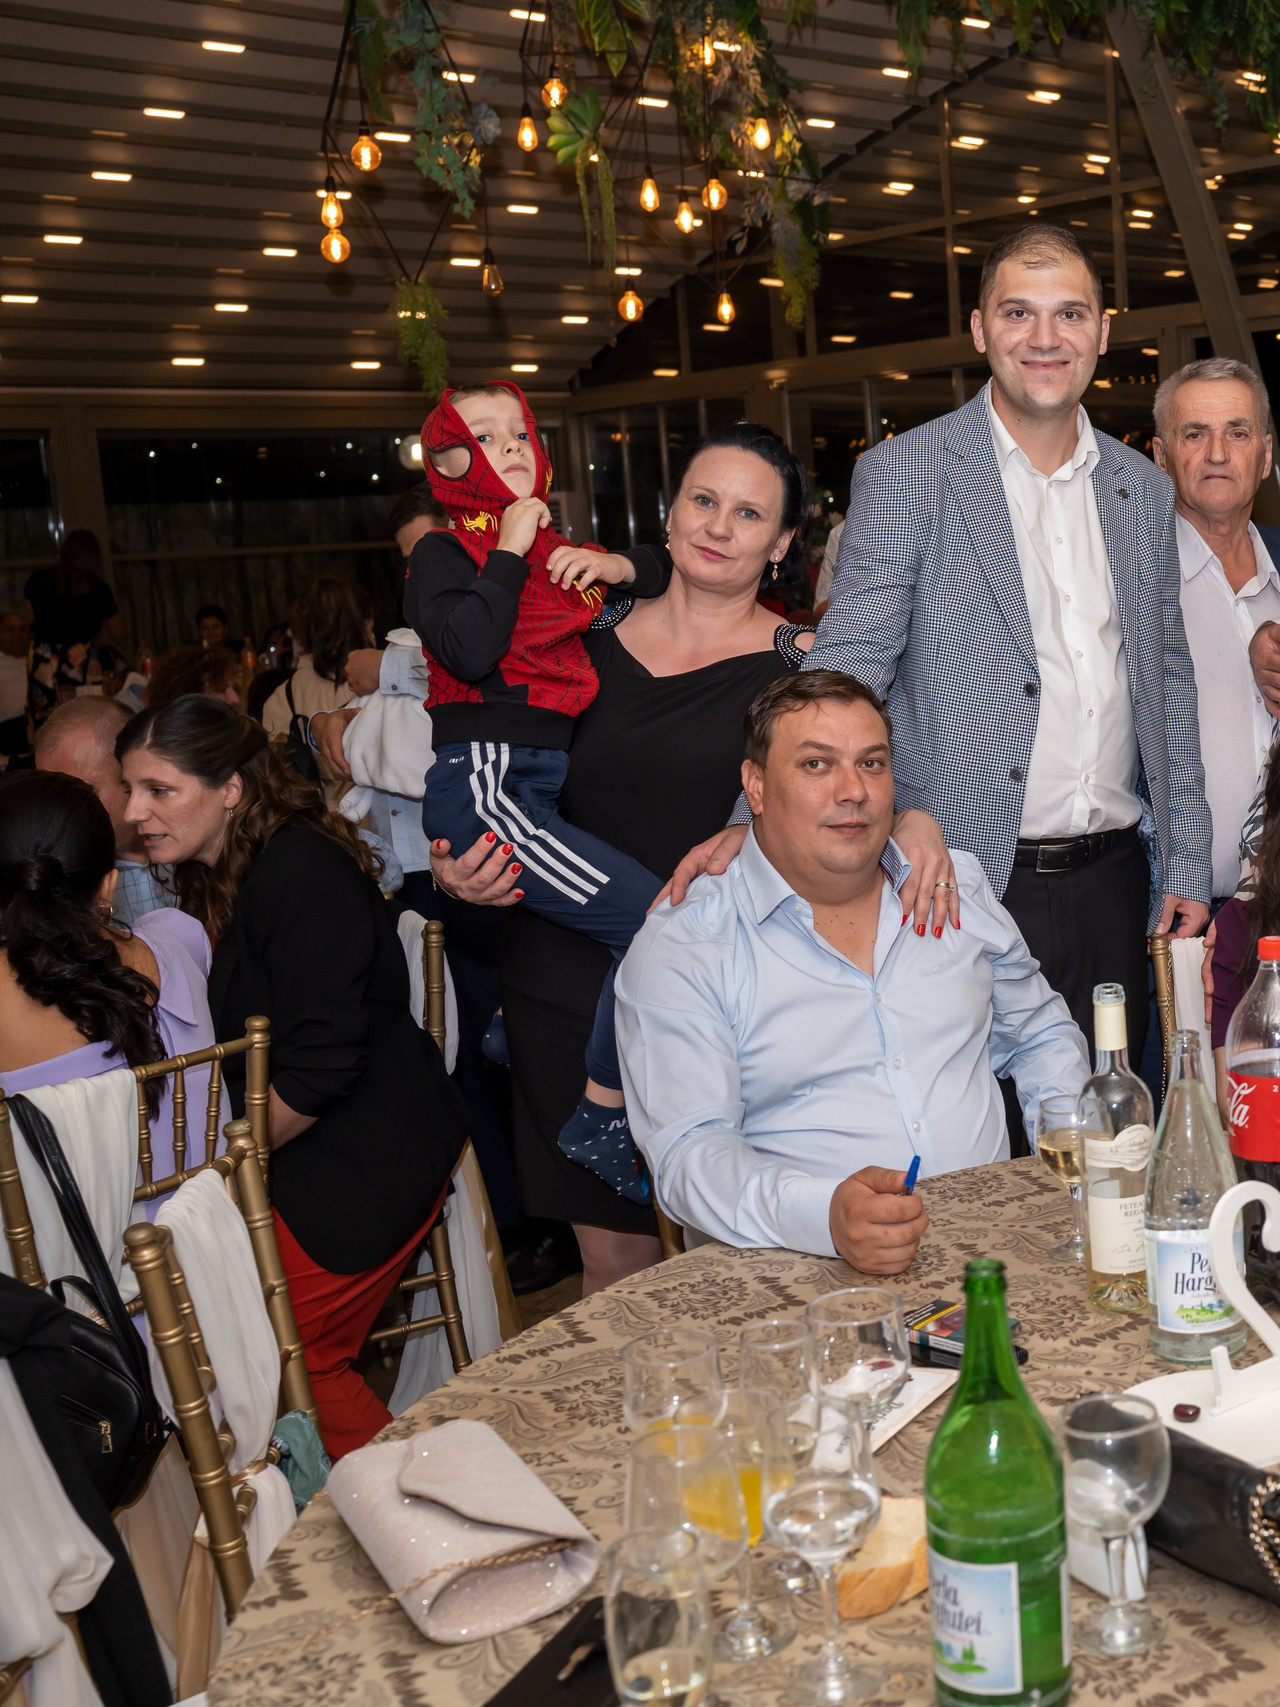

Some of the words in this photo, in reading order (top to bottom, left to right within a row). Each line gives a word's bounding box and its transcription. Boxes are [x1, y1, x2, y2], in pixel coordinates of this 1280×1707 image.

[1119, 1200, 1145, 1211] FETEA
[1190, 1252, 1211, 1274] Pe
[1174, 1272, 1217, 1295] Harg
